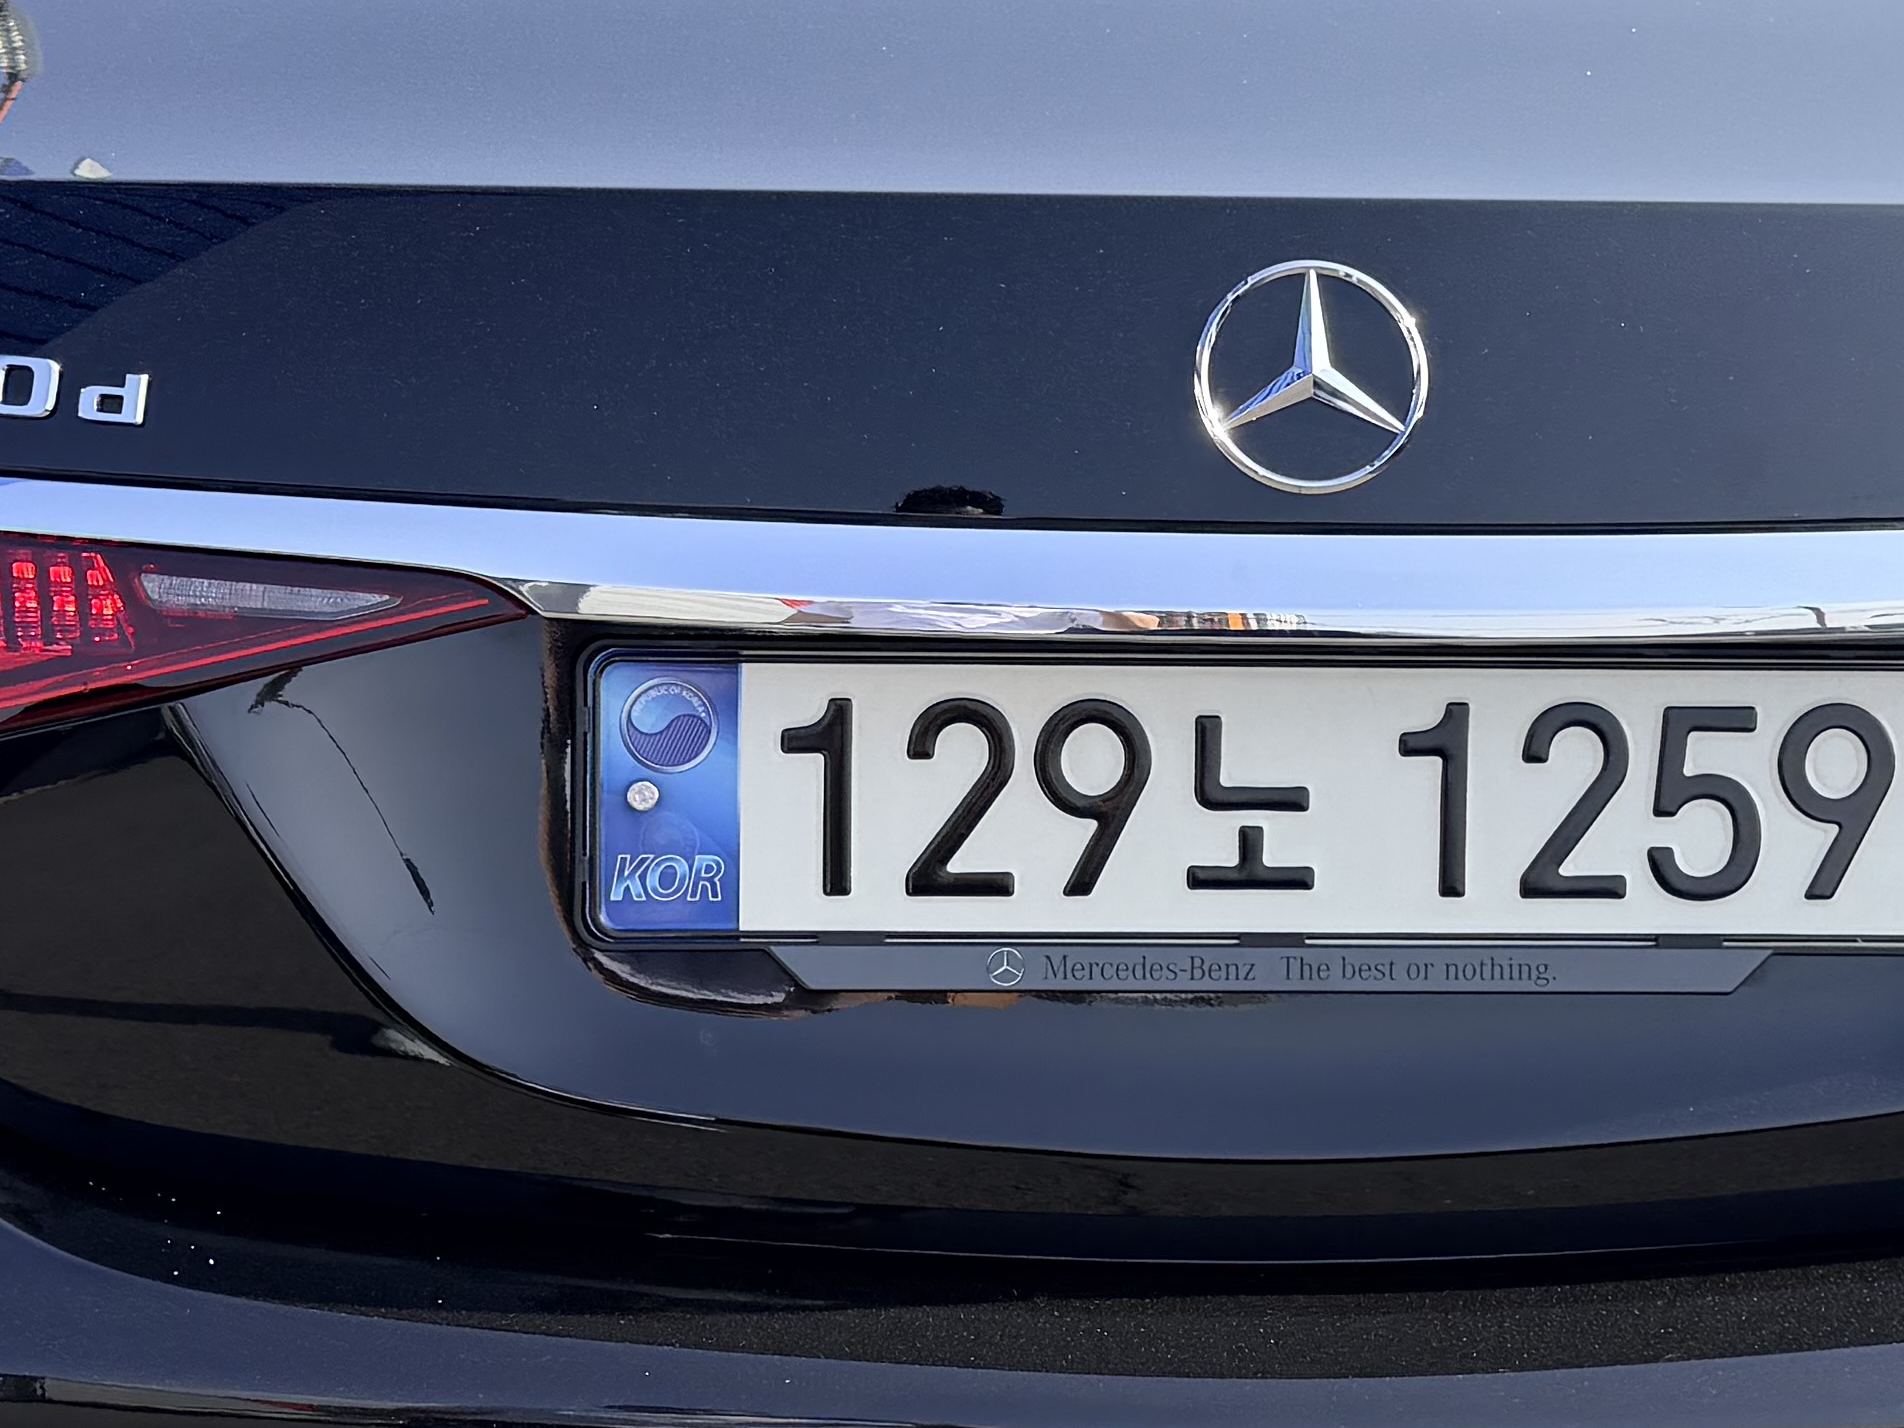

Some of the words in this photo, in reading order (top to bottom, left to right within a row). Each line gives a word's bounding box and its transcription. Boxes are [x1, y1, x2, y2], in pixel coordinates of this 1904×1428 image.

[780, 697, 1315, 898] 129노
[1398, 701, 1896, 902] 1259
[609, 854, 726, 902] KOR
[1042, 954, 1257, 983] Mercedes-Benz
[1280, 956, 1331, 982] The
[1341, 957, 1397, 982] best
[1406, 962, 1435, 982] or
[1444, 957, 1558, 987] nothing.
